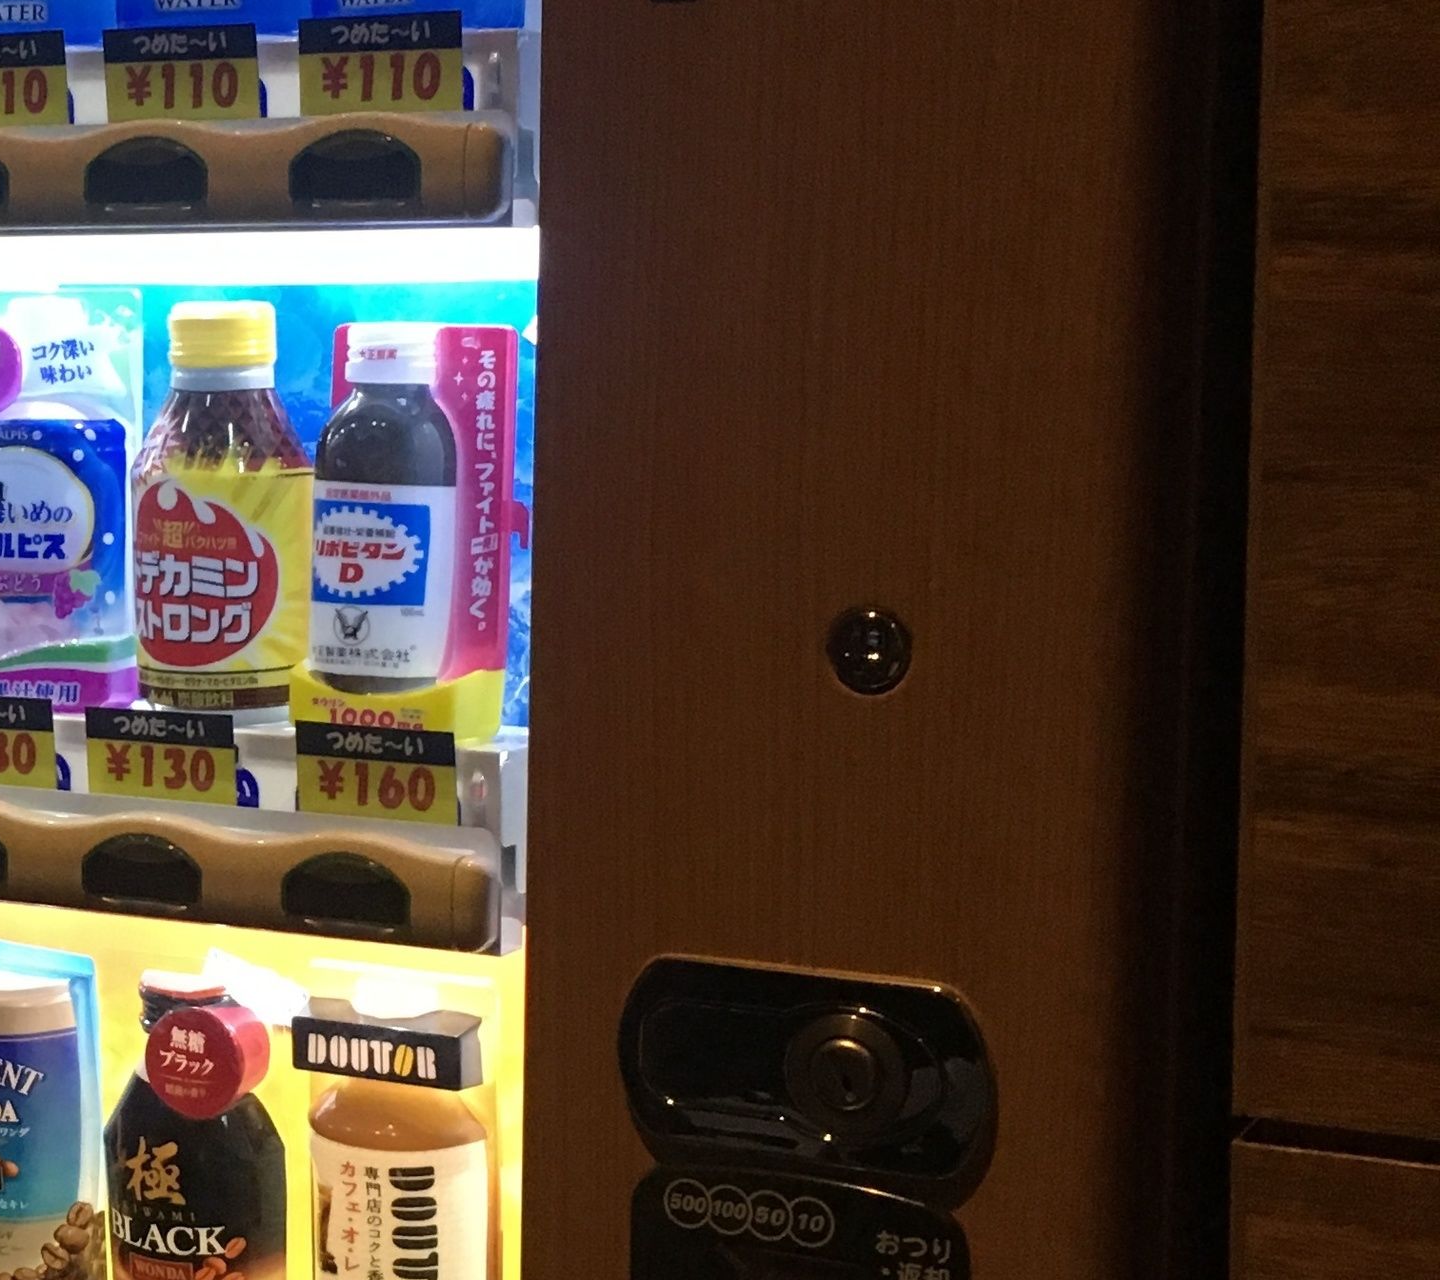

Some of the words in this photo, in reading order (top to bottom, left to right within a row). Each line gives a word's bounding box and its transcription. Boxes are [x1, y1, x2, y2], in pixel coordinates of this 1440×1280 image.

[125, 61, 239, 110] ¥110
[320, 51, 442, 102] ¥110
[32, 339, 95, 362] コク深い
[39, 363, 94, 385] 味わい
[316, 540, 407, 562] リポビタン
[339, 562, 364, 584] D
[105, 742, 216, 793] ¥130
[317, 759, 436, 812] ¥160
[170, 1025, 206, 1054] 無糖
[307, 1031, 439, 1081] DOUTOR
[160, 1049, 215, 1076] ブラック
[125, 1135, 187, 1206] 極
[111, 1207, 227, 1257] BLACK
[669, 1192, 708, 1215] 500
[712, 1199, 748, 1221] 100
[754, 1206, 787, 1227] 50
[797, 1213, 825, 1234] 10
[875, 1229, 952, 1264] おつり
